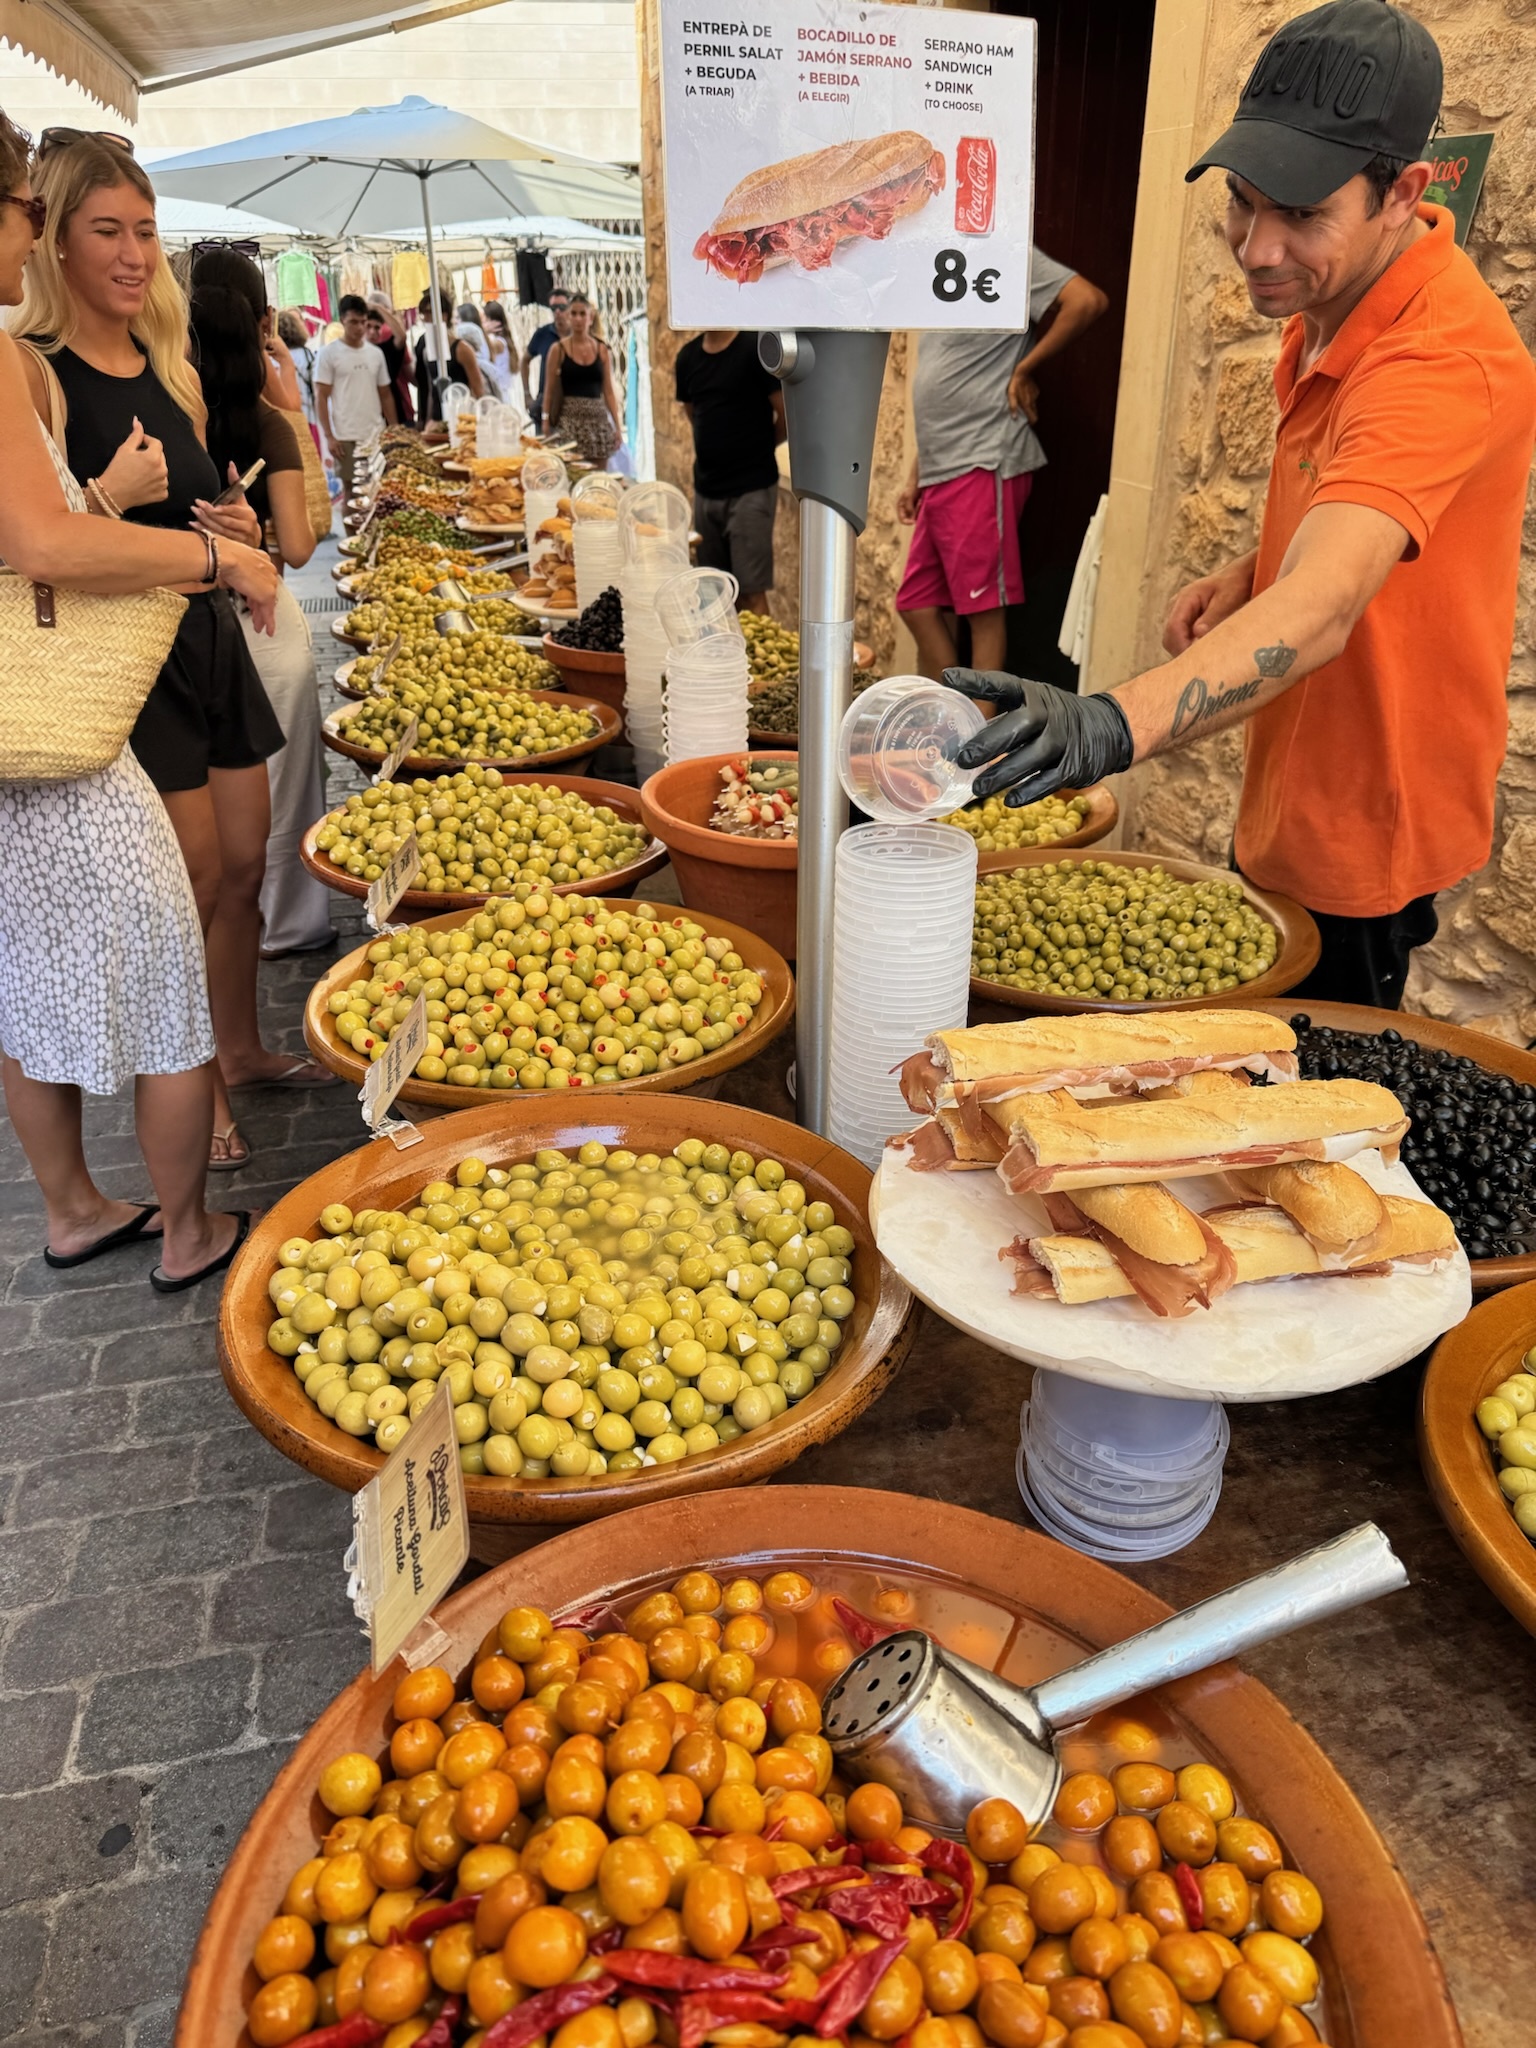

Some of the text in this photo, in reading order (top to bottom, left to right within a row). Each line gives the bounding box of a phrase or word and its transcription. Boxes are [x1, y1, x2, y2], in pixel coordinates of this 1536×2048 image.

[683, 20, 772, 38] ENTREPÀ DE
[797, 28, 896, 47] BOCADILLO DE
[684, 43, 783, 60] PERNIL SALAT
[924, 38, 1014, 58] SERRANO HAM
[797, 48, 912, 69] JAMÓN SERRANO
[697, 66, 756, 80] BEGUDA
[924, 59, 992, 76] SANDWICH
[809, 72, 860, 87] BEBIDA
[935, 81, 973, 95] DRINK
[685, 85, 734, 98] (A TRIAR)
[798, 91, 850, 105] (A ELEGIR)
[925, 98, 983, 114] (TO CHOOSE)
[932, 248, 1001, 302] 8€
[404, 1458, 424, 1595] Aceituna Gordal
[393, 1505, 406, 1574] Picante
